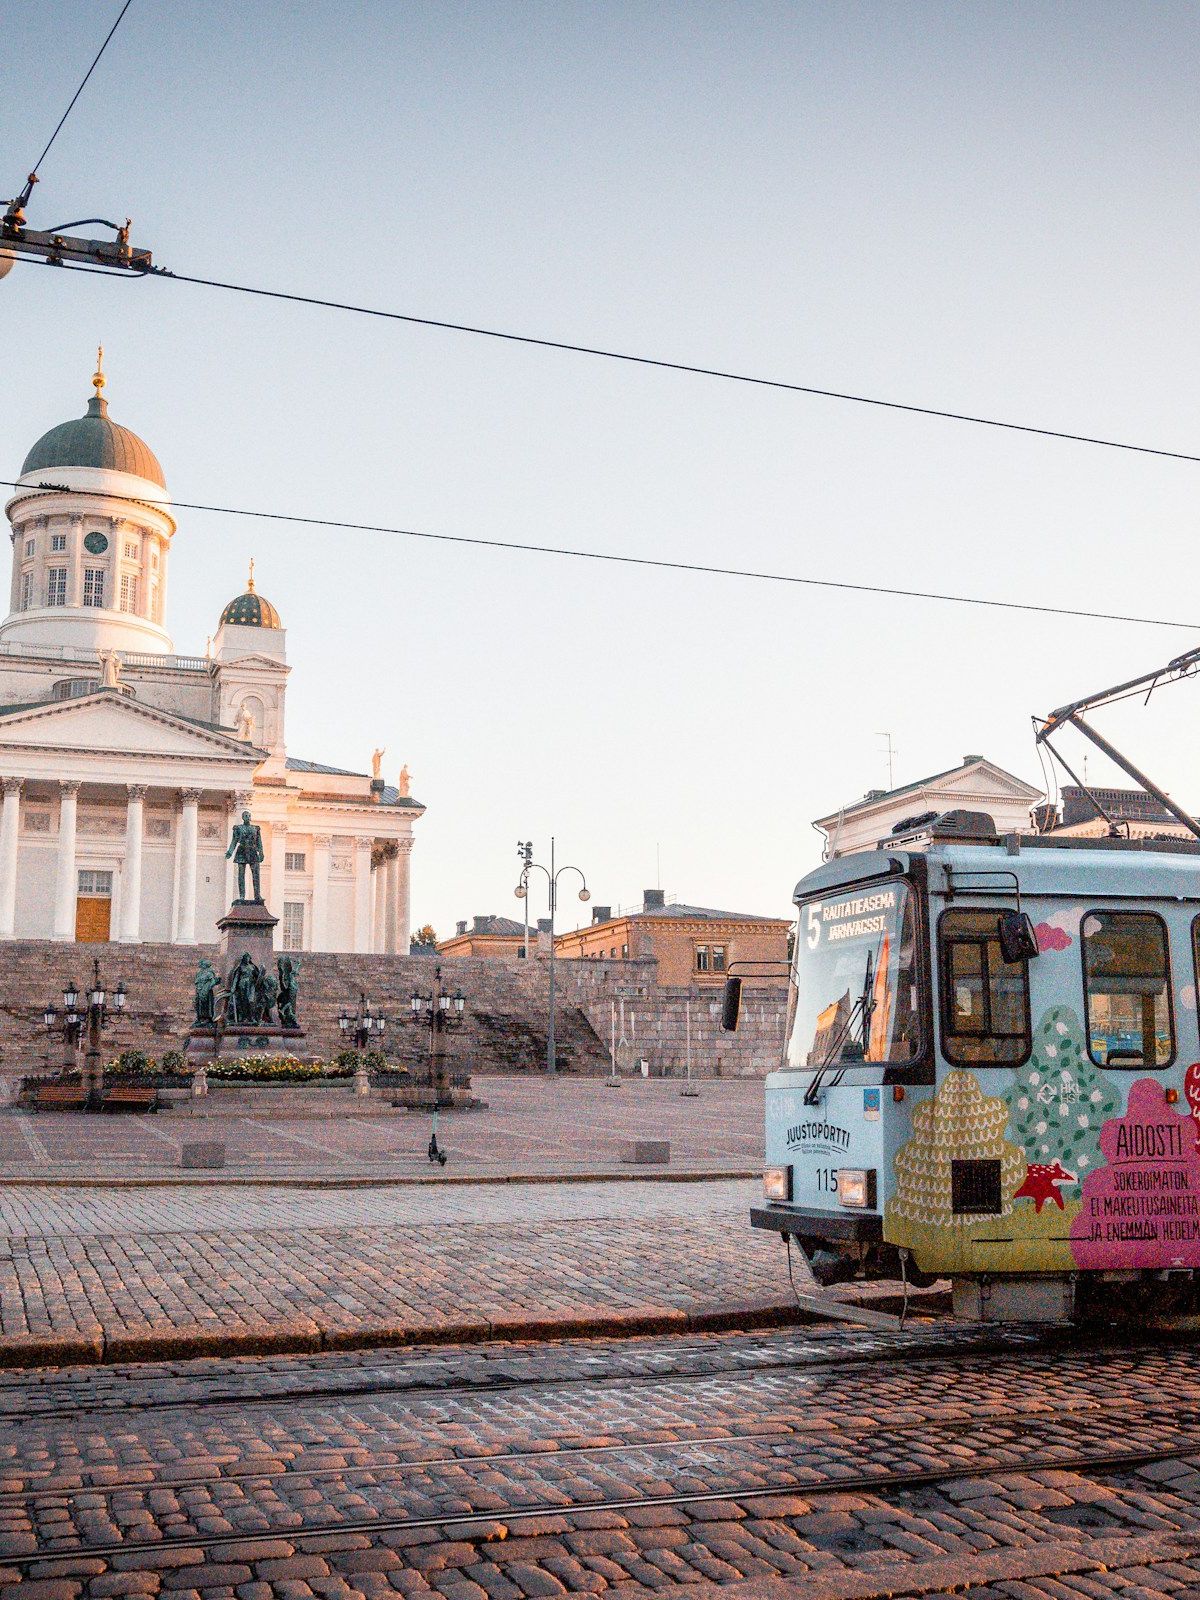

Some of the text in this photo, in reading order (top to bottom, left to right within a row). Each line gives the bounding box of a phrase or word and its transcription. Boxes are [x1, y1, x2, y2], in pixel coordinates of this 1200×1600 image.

[822, 892, 895, 921] RAUTATIEASEMA
[807, 903, 822, 950] 5
[786, 1122, 851, 1148] JUUSTOPORTTI
[1116, 1124, 1183, 1157] AIDOSTI
[816, 1168, 838, 1193] 115
[1090, 1195, 1199, 1217] EI MAKEUTUSAINEITA
[1088, 1222, 1103, 1242] JA
